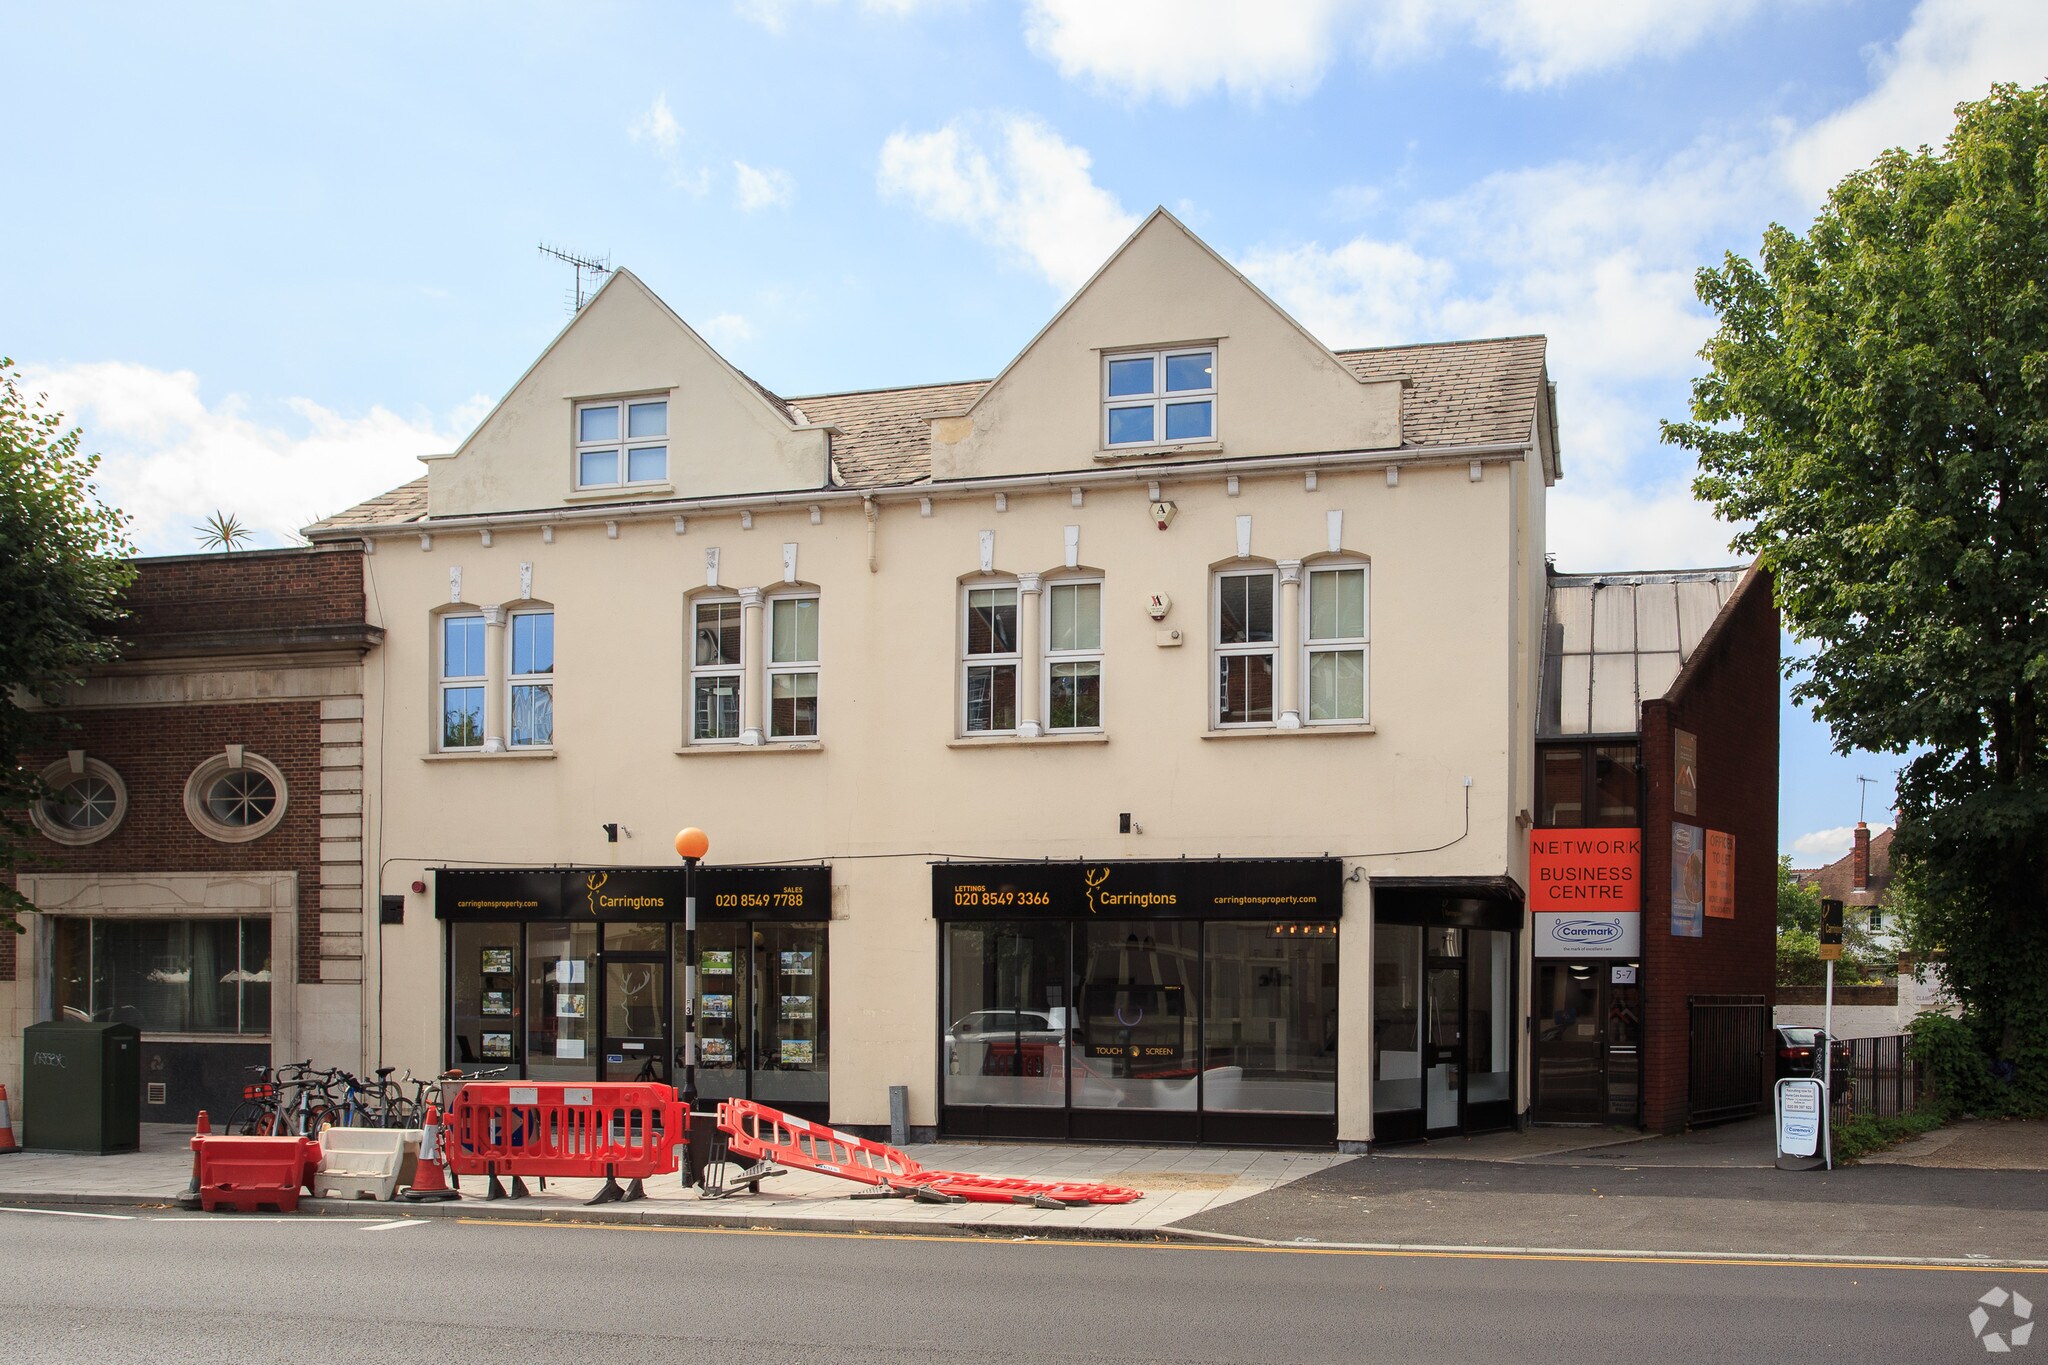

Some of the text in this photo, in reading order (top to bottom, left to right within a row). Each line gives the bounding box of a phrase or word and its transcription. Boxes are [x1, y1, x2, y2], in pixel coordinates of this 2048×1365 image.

[1533, 840, 1640, 855] NETWORK
[1712, 852, 1720, 864] TO
[1540, 867, 1633, 881] BUSINESS
[1549, 885, 1624, 899] CENTRE
[457, 899, 538, 909] carringtonsproperty.com
[600, 895, 664, 910] Carringtons
[715, 894, 803, 907] 020 8549 7788
[954, 892, 1050, 906] 020 8549 3366
[1100, 891, 1177, 908] Carringtons
[1214, 895, 1317, 906] carringtonsproperty.com
[1562, 927, 1614, 936] Caremark
[1615, 970, 1632, 980] 5-7
[1096, 1047, 1174, 1055] TOUCH SCREEN
